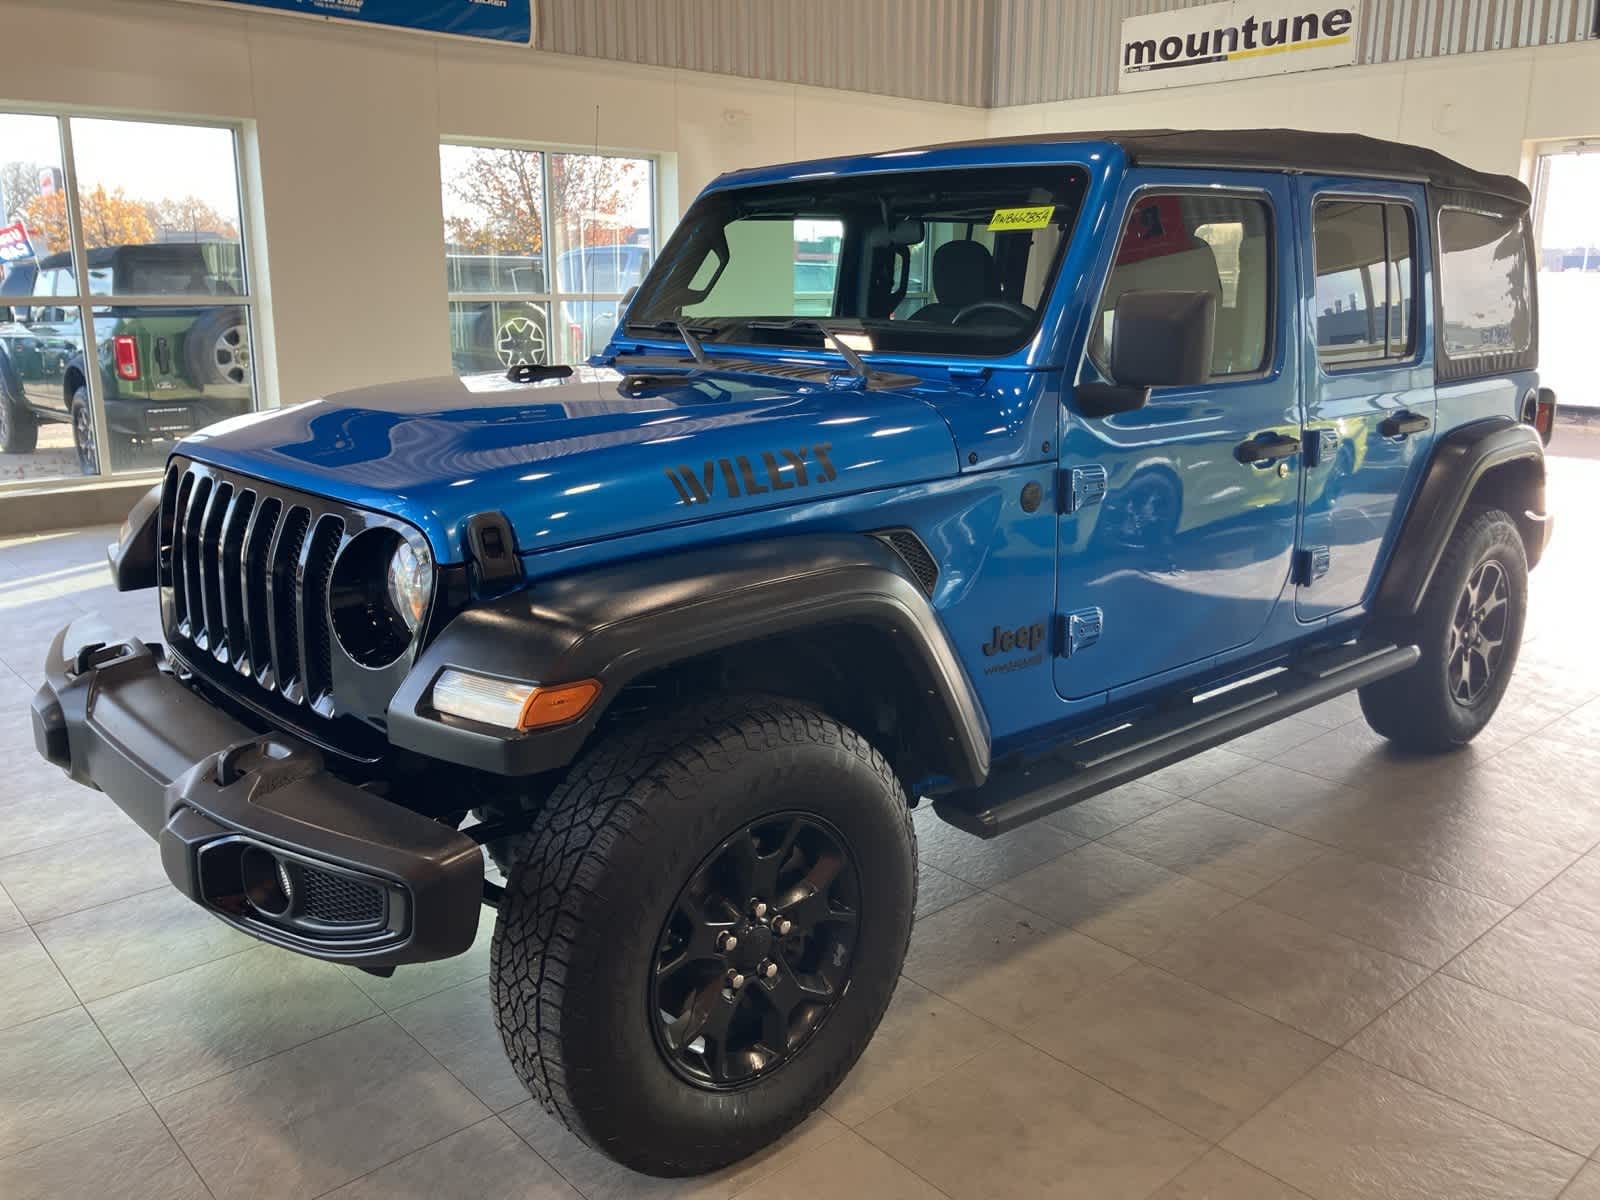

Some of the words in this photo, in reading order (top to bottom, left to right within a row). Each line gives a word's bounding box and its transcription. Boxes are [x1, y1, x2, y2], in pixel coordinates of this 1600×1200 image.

[1124, 8, 1352, 66] mountune
[664, 442, 837, 506] WILLYS
[982, 624, 1044, 657] Jeep
